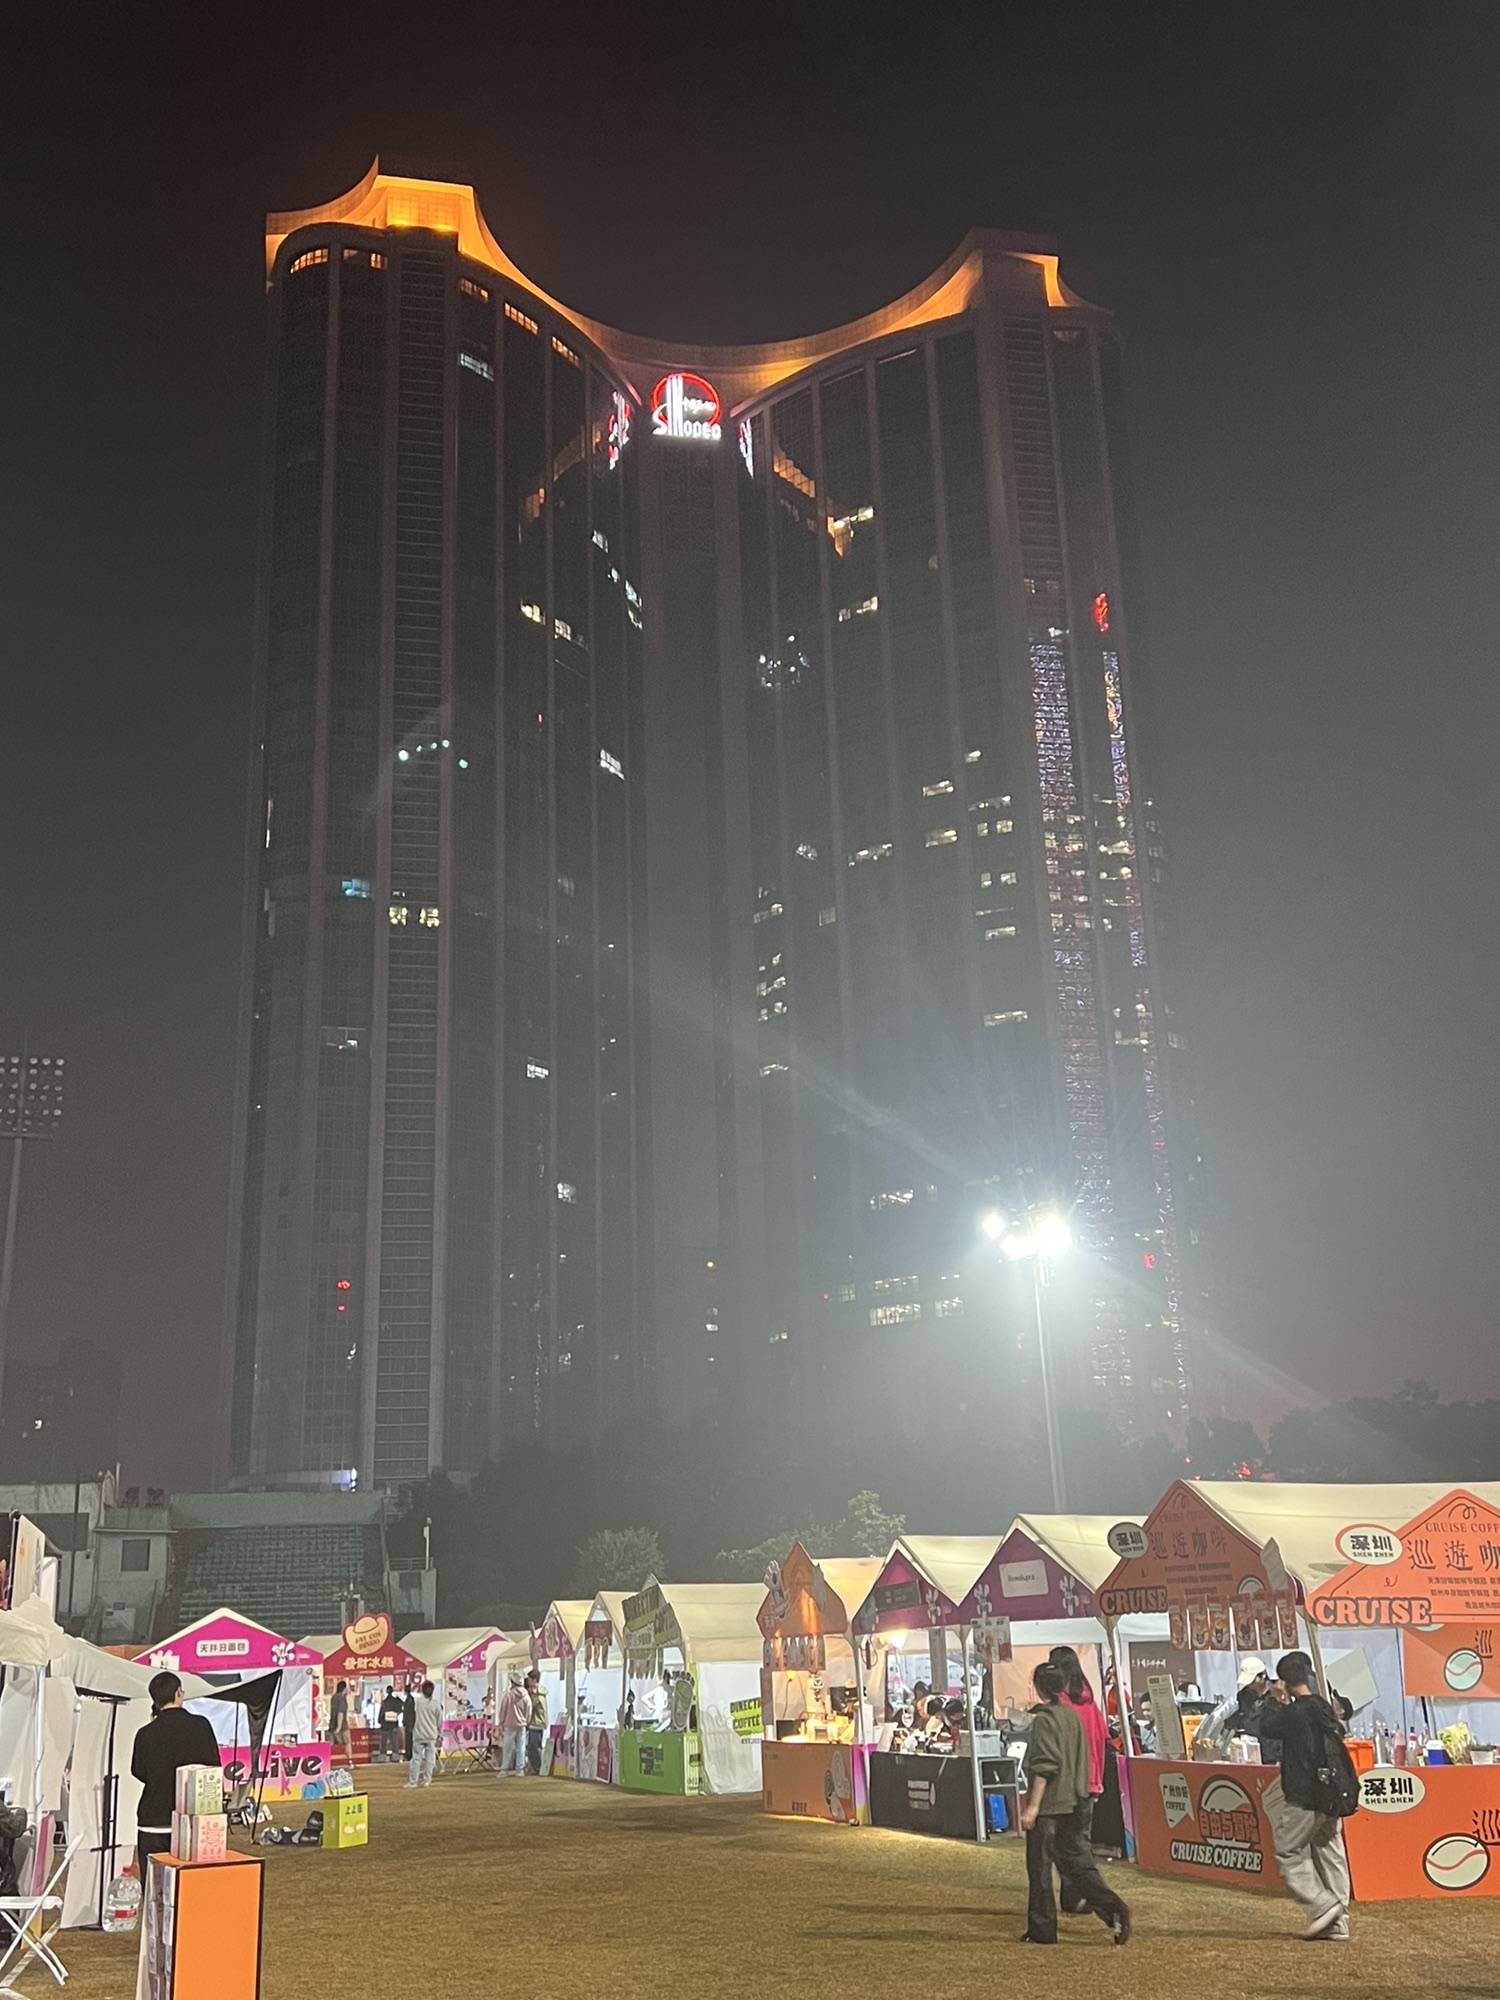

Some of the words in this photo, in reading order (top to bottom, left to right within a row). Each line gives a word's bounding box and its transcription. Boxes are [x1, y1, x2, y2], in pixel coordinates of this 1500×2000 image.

[1425, 1522, 1467, 1533] CRUISE
[1115, 1530, 1143, 1546] 深圳
[1350, 1535, 1393, 1551] 深圳
[1101, 1587, 1168, 1615] CRUISE
[1315, 1598, 1430, 1625] CRUISE
[733, 1714, 760, 1730] COFFEE
[1363, 1777, 1414, 1796] 深圳
[1165, 1800, 1186, 1811] COFFEE
[1170, 1841, 1213, 1864] CRUISE
[1213, 1848, 1263, 1872] COFFEE
